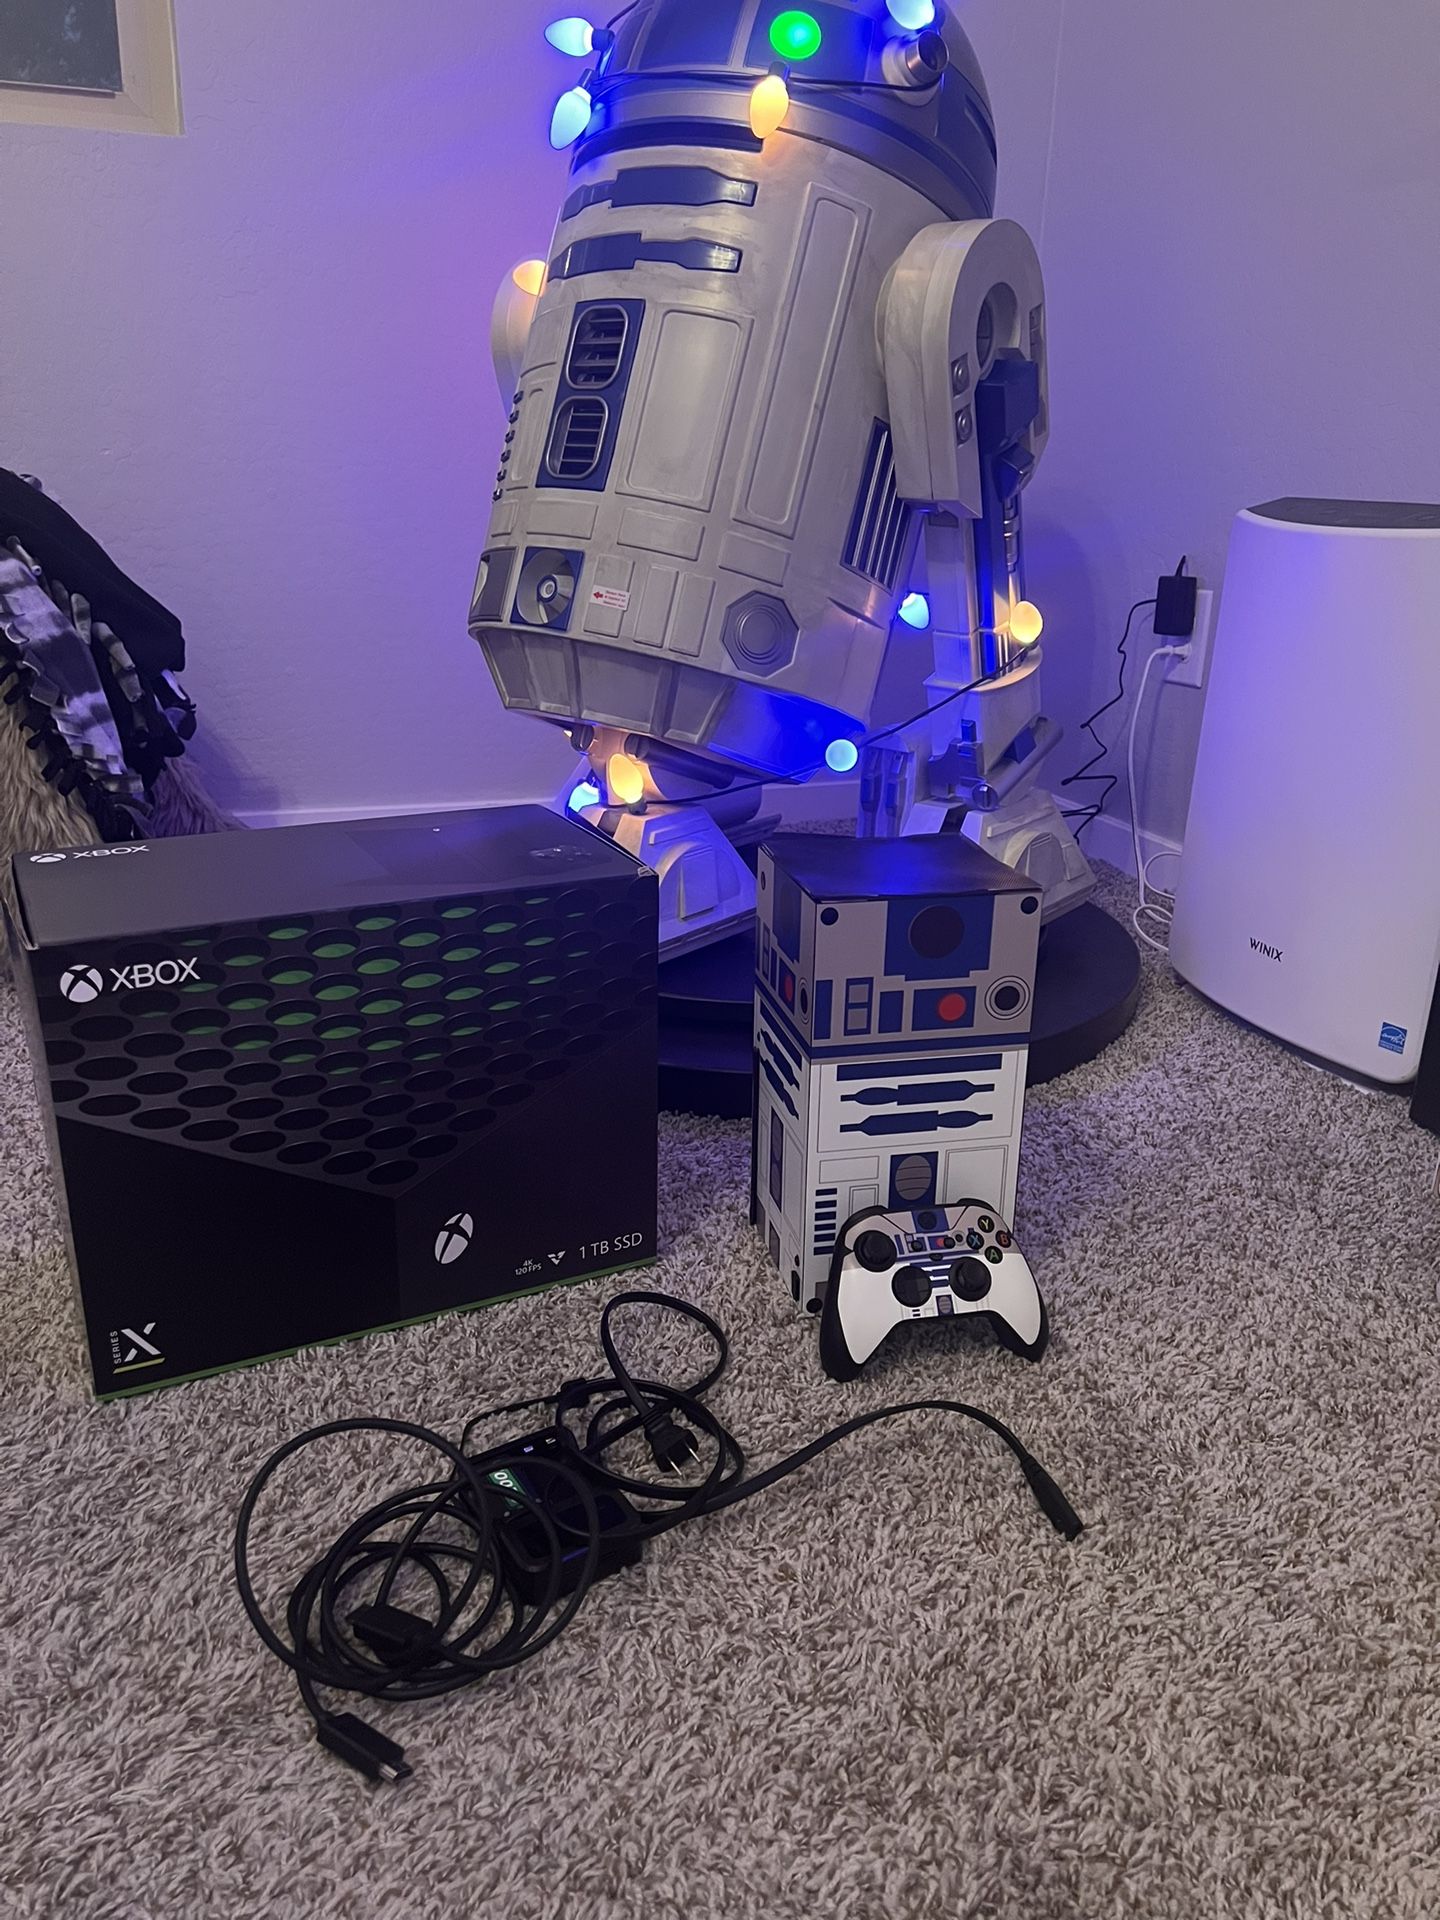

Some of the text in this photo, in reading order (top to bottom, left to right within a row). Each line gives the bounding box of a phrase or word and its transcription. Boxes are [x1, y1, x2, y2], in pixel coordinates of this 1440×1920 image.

[72, 845, 149, 859] XBOX
[1249, 936, 1284, 963] WINIX
[109, 957, 200, 992] XBOX
[981, 1218, 989, 1230] Y
[970, 1234, 981, 1247] X
[1000, 1233, 1009, 1245] B
[579, 1232, 643, 1260] 1 TB SSD
[990, 1249, 1000, 1261] A
[523, 1258, 534, 1266] 4K
[528, 1262, 542, 1272] FPS
[110, 1322, 161, 1364] SERIES X
